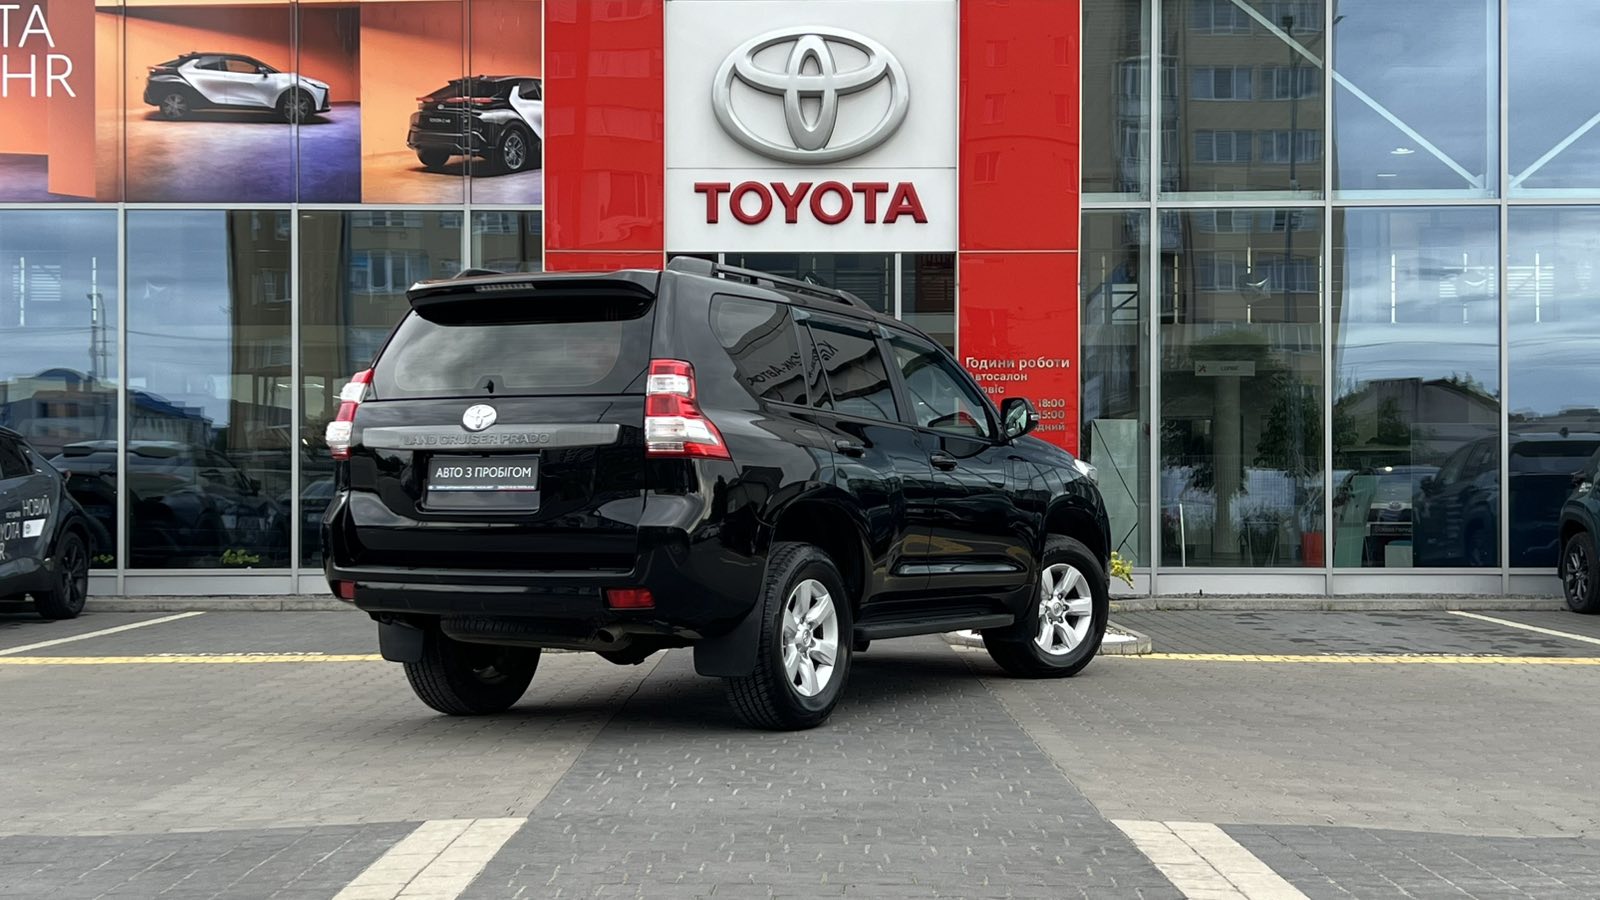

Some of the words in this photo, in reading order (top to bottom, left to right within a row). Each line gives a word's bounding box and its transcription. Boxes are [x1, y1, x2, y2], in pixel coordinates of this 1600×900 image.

[0, 4, 55, 48] TA
[2, 54, 77, 98] HR
[694, 181, 928, 225] TOYOTA
[965, 357, 1015, 370] Години
[1019, 356, 1070, 371] роботи
[404, 433, 438, 446] LAND
[439, 433, 498, 445] CRUISER
[501, 432, 550, 444] PRADO
[435, 466, 463, 478] АВТО
[474, 466, 532, 478] ПРОБІГОМ
[22, 494, 51, 516] НОВИЙ
